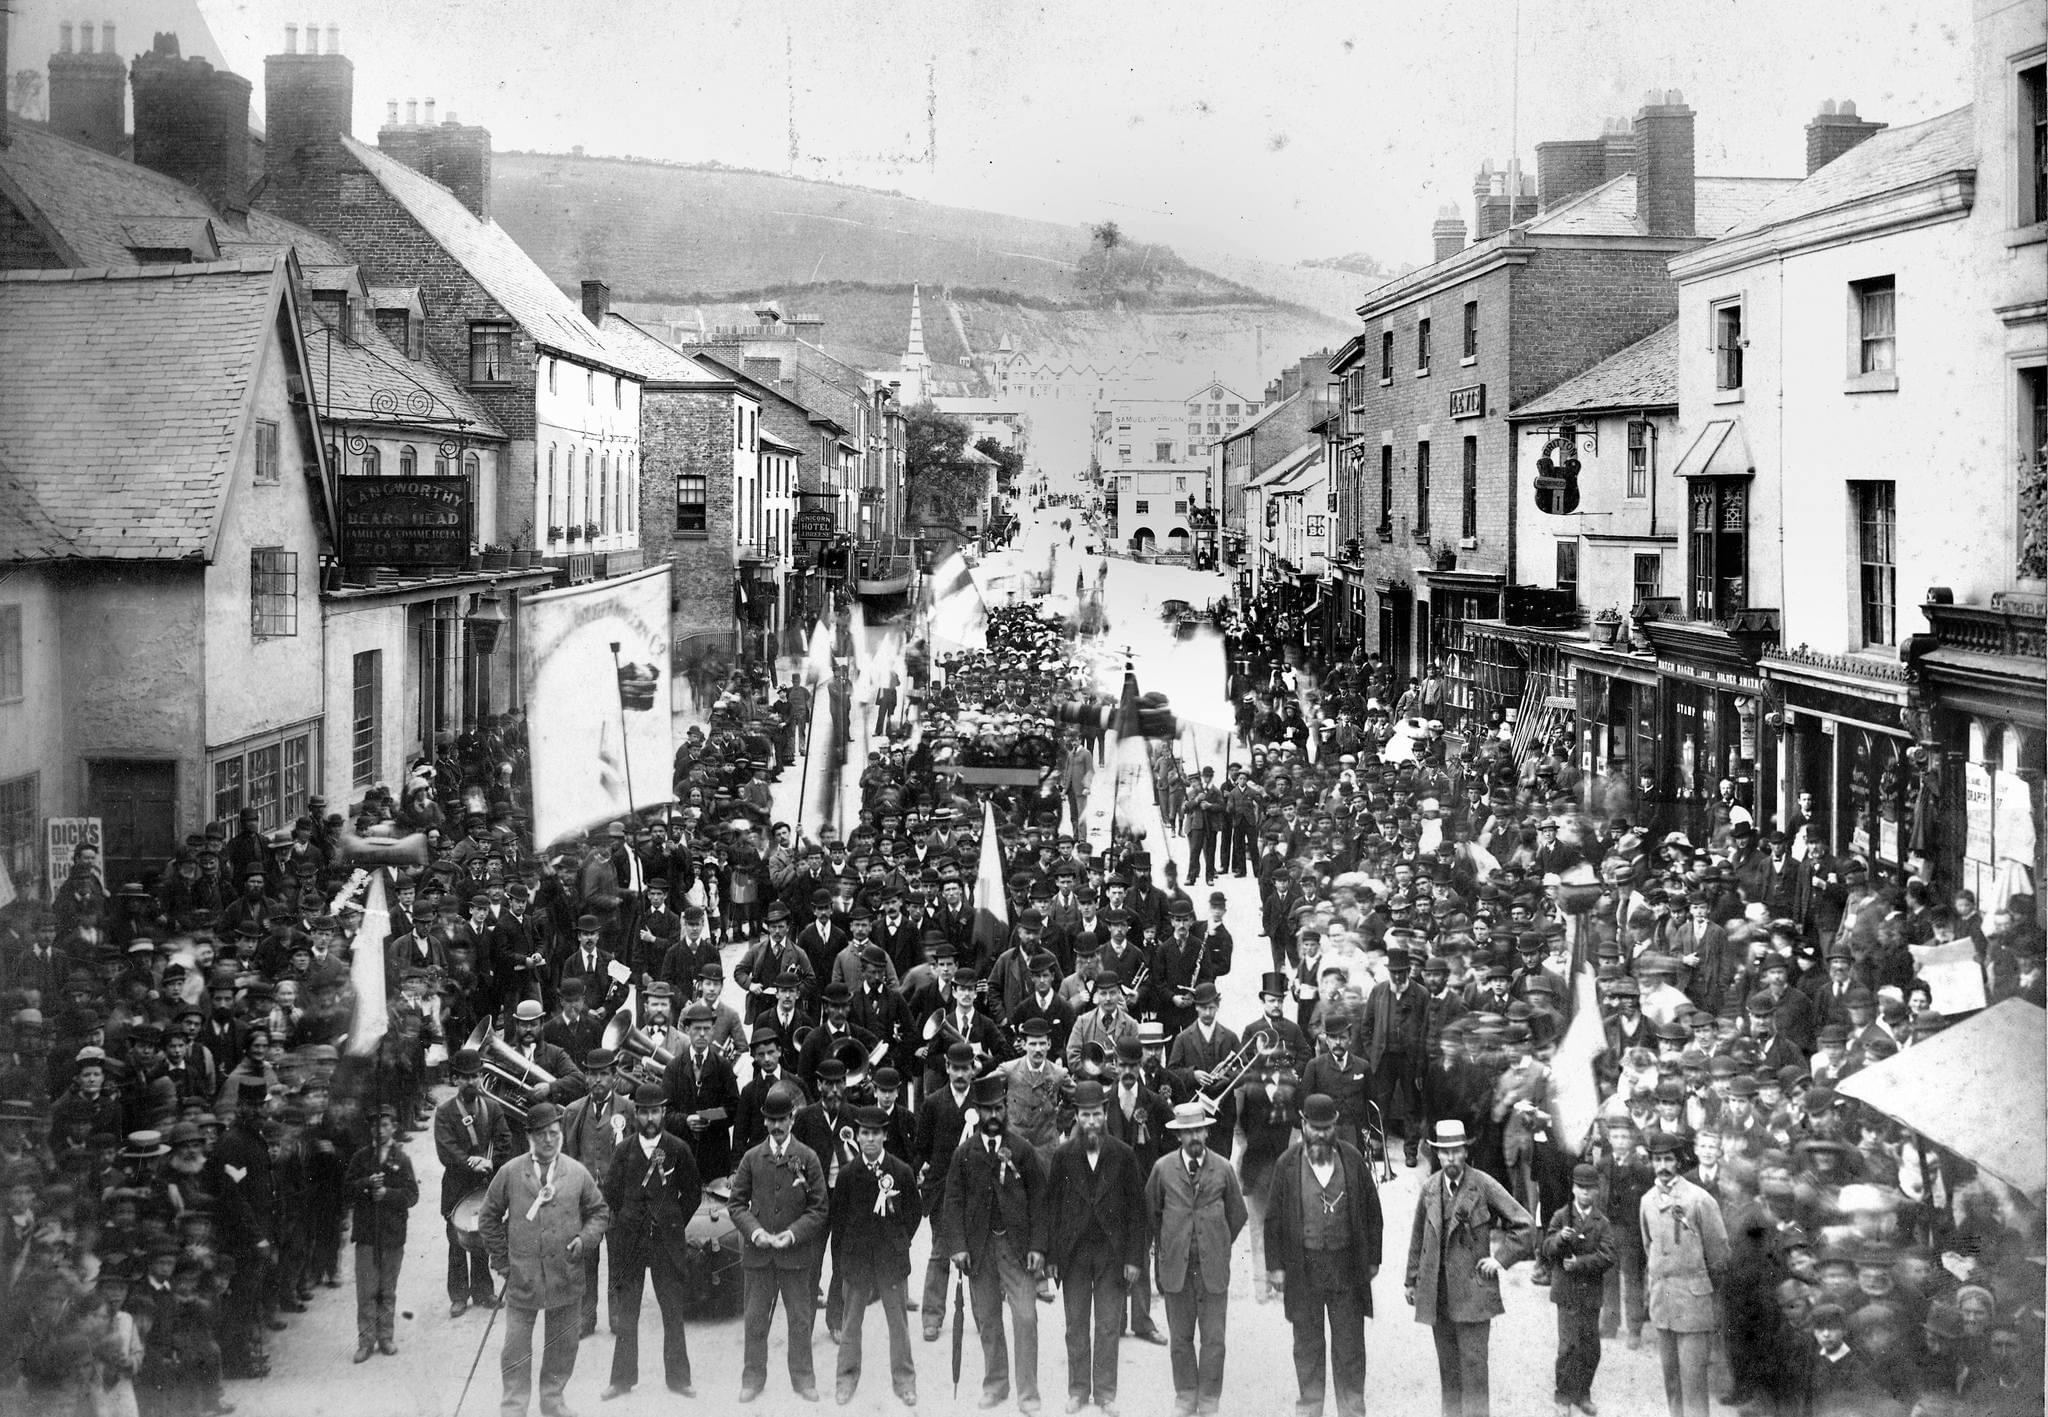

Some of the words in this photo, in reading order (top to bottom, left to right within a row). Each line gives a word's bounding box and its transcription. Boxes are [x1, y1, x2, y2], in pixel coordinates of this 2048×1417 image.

[1543, 438, 1577, 458] BRITTON
[412, 512, 460, 525] HEAD
[801, 515, 831, 523] UNICORN
[801, 523, 830, 531] HOTEL
[346, 529, 381, 539] FAMILY
[395, 529, 461, 539] COMMERCIAL
[1716, 672, 1737, 685] SILVER
[1739, 676, 1759, 689] SMITH
[1676, 703, 1696, 717] STAMP
[51, 823, 100, 846] DICKS
